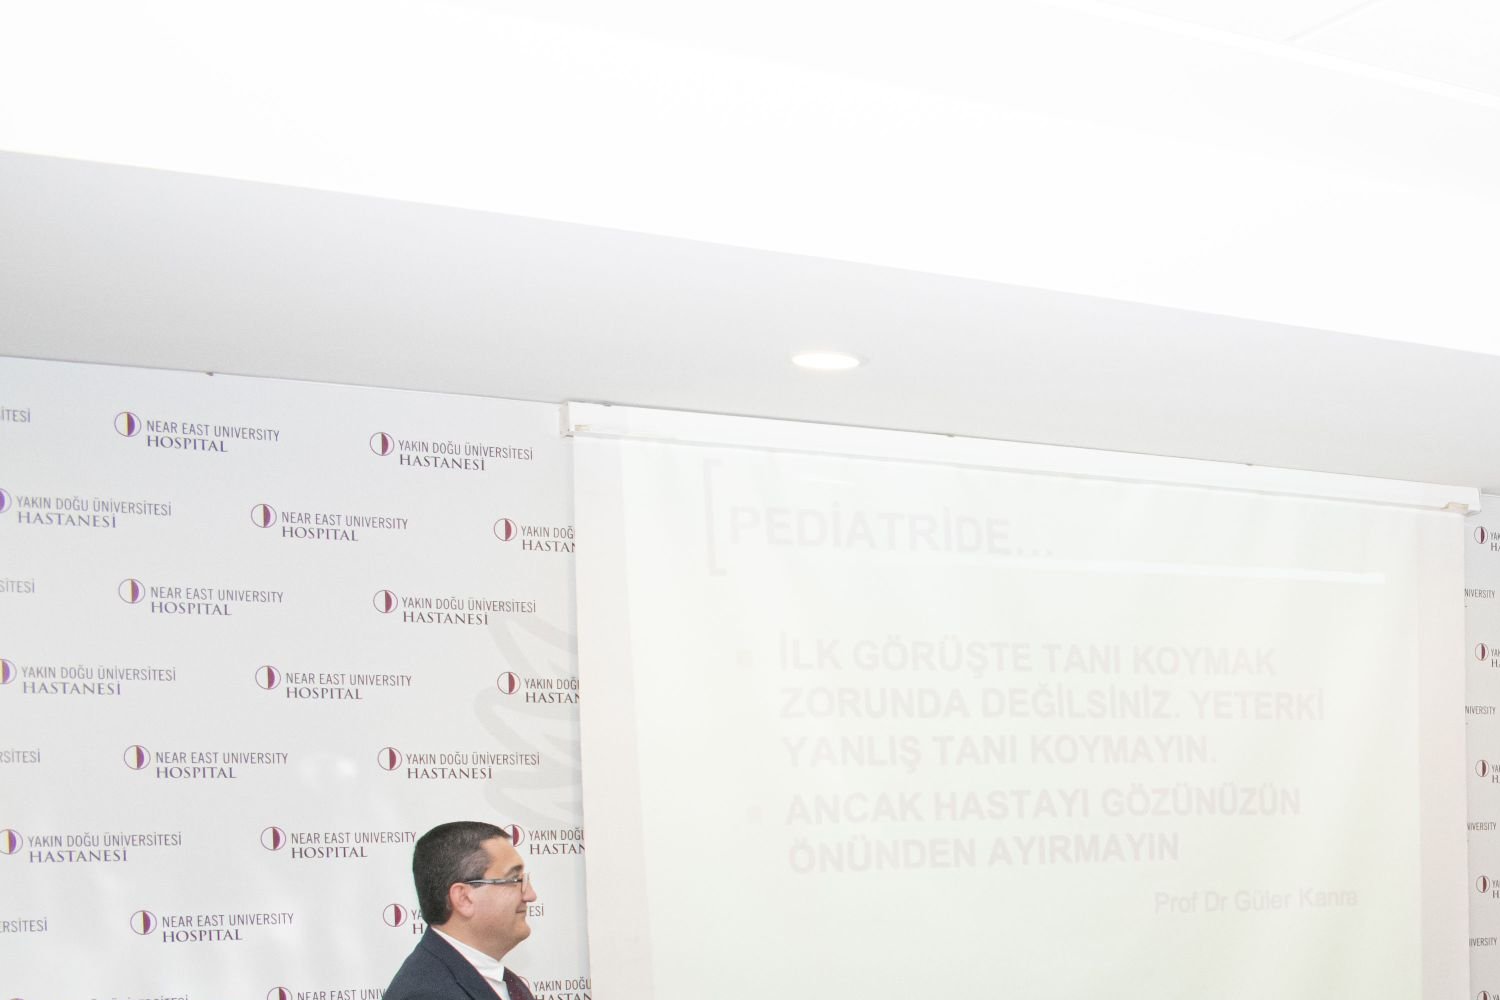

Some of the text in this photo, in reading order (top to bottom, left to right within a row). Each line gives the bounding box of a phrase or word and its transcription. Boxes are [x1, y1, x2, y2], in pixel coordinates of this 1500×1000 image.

[146, 420, 279, 441] NEAR EAST UNIVERSITY
[147, 436, 227, 452] HOSPITAL
[398, 440, 532, 460] YAKIN DOĞU ÜNİVERSİTESİ
[400, 454, 484, 470] HASTANESİ
[16, 496, 171, 516] YAKIN DOĞU ÜNİVERSİTESİ
[18, 511, 115, 528] HASTANESİ
[281, 511, 407, 529] NEAR EAST UNIVERSITY
[282, 526, 358, 541] HOSPITAL
[521, 525, 549, 537] YAKIN
[150, 586, 283, 603] NEAR EAST UNIVERSITY
[151, 601, 231, 615] HOSPITAL
[401, 597, 535, 612] YAKIN DOĞU ÜNİVERSİTESİ
[403, 611, 487, 624] HASTANESİ
[780, 633, 1276, 677] İLK GÖRÜŞTE TANI KOYMAK
[21, 665, 175, 681] YAKIN DOĞU ÜNİVERSİTESİ
[286, 672, 411, 686] NEAR EAST UNIVERSITY
[23, 681, 120, 695] HASTANESİ
[524, 678, 552, 689] YAKIN
[286, 687, 361, 699] HOSPITAL
[779, 684, 1325, 720] ZORUNDA DEĞİLSİNİZ. YETERKİ
[156, 751, 288, 764] NEAR EAST UNIVERSITY
[406, 752, 539, 767] YAKIN DOĞU ÜNİVERSİTESİ
[781, 734, 1217, 773] YANLIŞ TANI KOYMAYIN.
[156, 766, 236, 778] HOSPITAL
[407, 767, 491, 778] HASTANESİ
[786, 782, 1300, 824] ANCAK HASTAYI GÖZÜNÜZÜN
[27, 831, 181, 847] YAKIN DOĞU ÜNİVERSİTESİ
[291, 832, 416, 844] NEAR EAST UNIVERSITY
[528, 830, 556, 840] YAKIN
[29, 849, 126, 862] HASTANESİ
[292, 846, 367, 858] HOSPITAL
[789, 832, 1178, 873] ÖNÜNDEN AYIRMAYIN
[1204, 890, 1228, 912] Dr
[1299, 888, 1357, 907] Kanra
[162, 913, 293, 927] NEAR EAST UNIVERSITY
[163, 929, 241, 942] HOSPITAL
[533, 980, 561, 991] YAKIN
[330, 989, 356, 1000] EAST
